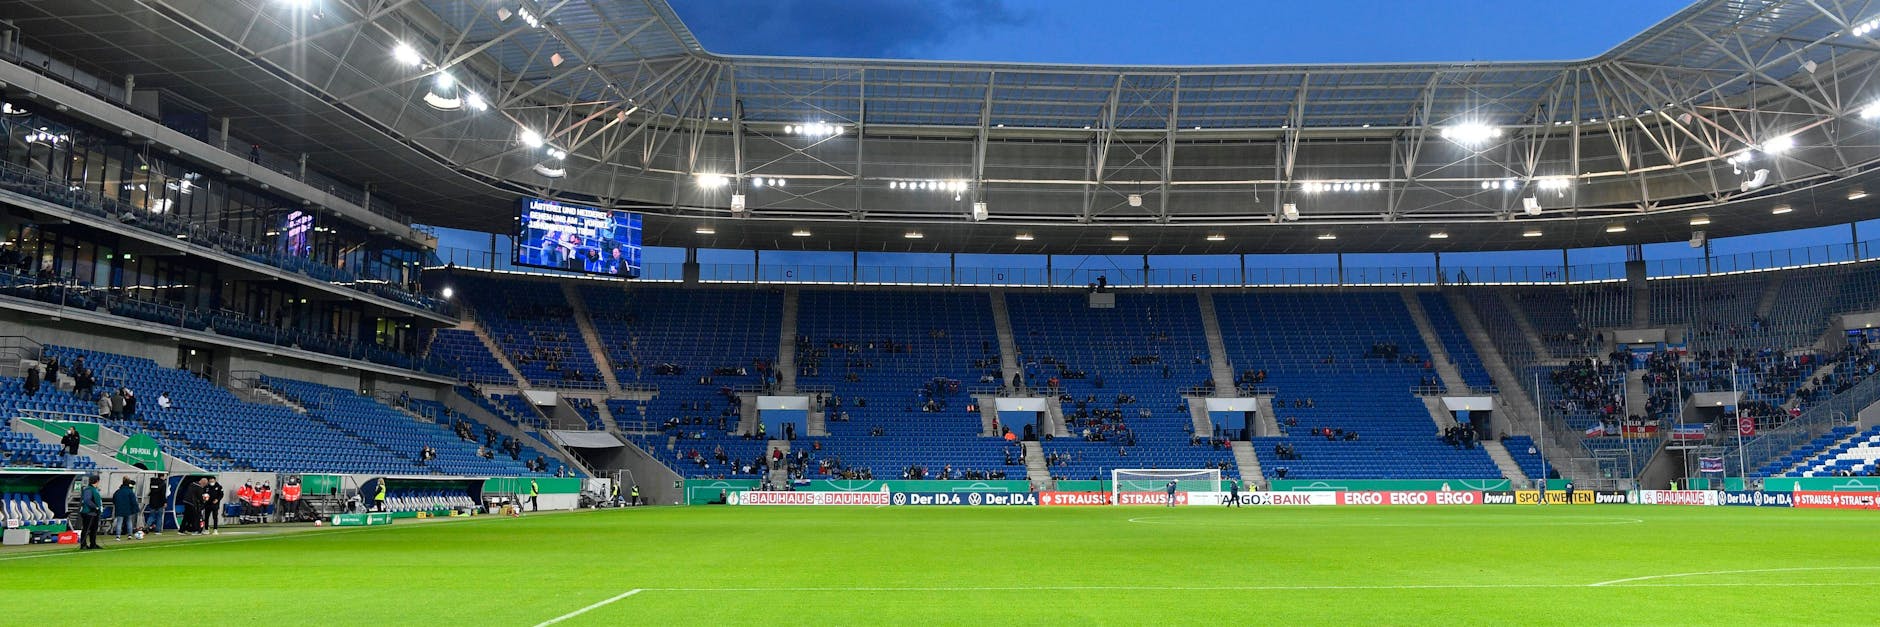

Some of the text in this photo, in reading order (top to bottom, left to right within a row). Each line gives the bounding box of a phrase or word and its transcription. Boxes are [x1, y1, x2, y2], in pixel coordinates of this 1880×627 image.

[786, 270, 793, 278] C
[997, 273, 1004, 281] D
[1191, 273, 1198, 281] E
[750, 493, 814, 504] BAUHAUS
[825, 493, 889, 504] BAUHAUS
[911, 493, 933, 504] Der
[935, 493, 960, 504] ID.4
[986, 493, 1004, 504] Der
[1011, 493, 1036, 504] ID.4
[1055, 493, 1104, 504] STRAUSS
[1344, 492, 1382, 504] ERGO
[1390, 492, 1428, 504] ERGO
[1436, 492, 1474, 504] ERGO
[1483, 492, 1514, 504] bwin
[1519, 492, 1591, 503] SPOTWETEN
[1596, 491, 1625, 503] bwin
[1657, 491, 1704, 504] BAUHAUS
[1727, 494, 1739, 504] Der
[1739, 494, 1752, 504] ID.4
[1763, 494, 1776, 504] Der
[1777, 494, 1792, 504] ID.4
[1801, 494, 1833, 505] STRAUSS
[1840, 495, 1874, 506] STRAUSS
